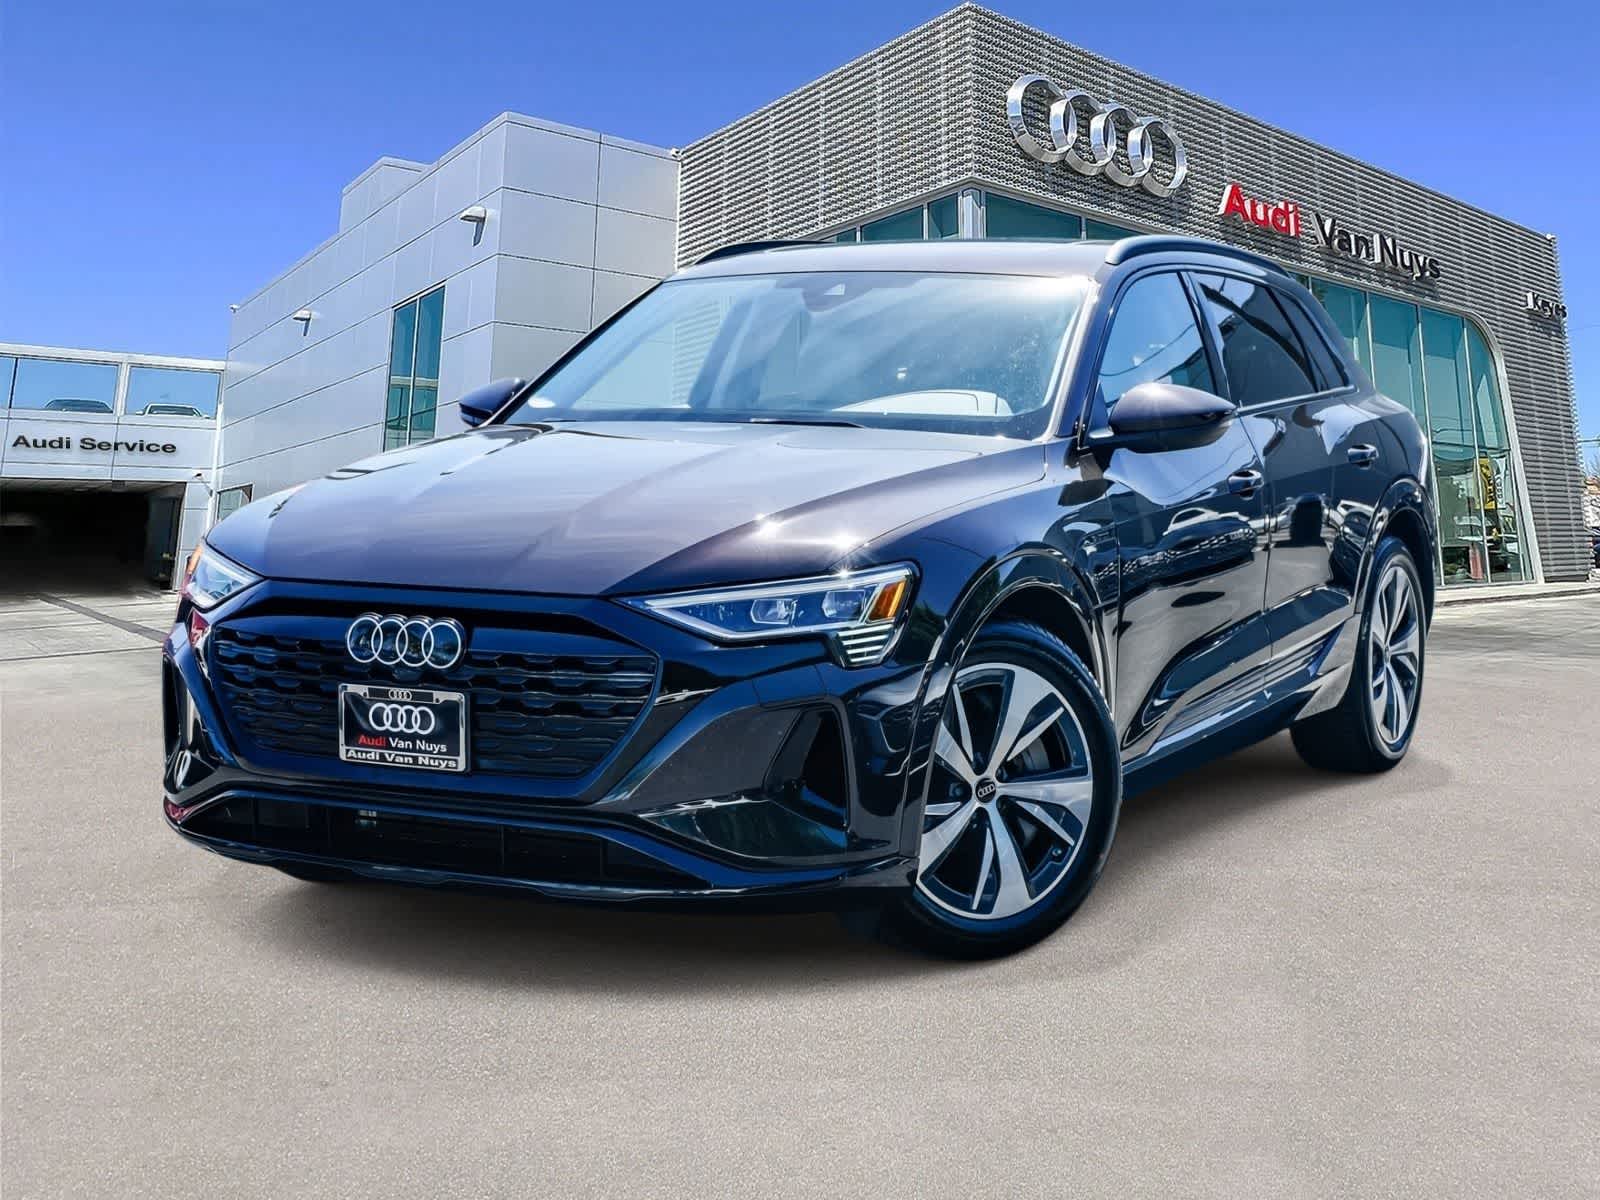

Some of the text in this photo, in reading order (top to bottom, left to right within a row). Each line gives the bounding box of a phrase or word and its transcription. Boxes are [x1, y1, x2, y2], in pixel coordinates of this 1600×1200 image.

[1217, 182, 1441, 280] Audi Van Nuys
[12, 435, 177, 453] Audi Service
[357, 734, 447, 754] Audi Van Nuys
[347, 750, 457, 769] Audi Van Nuys
